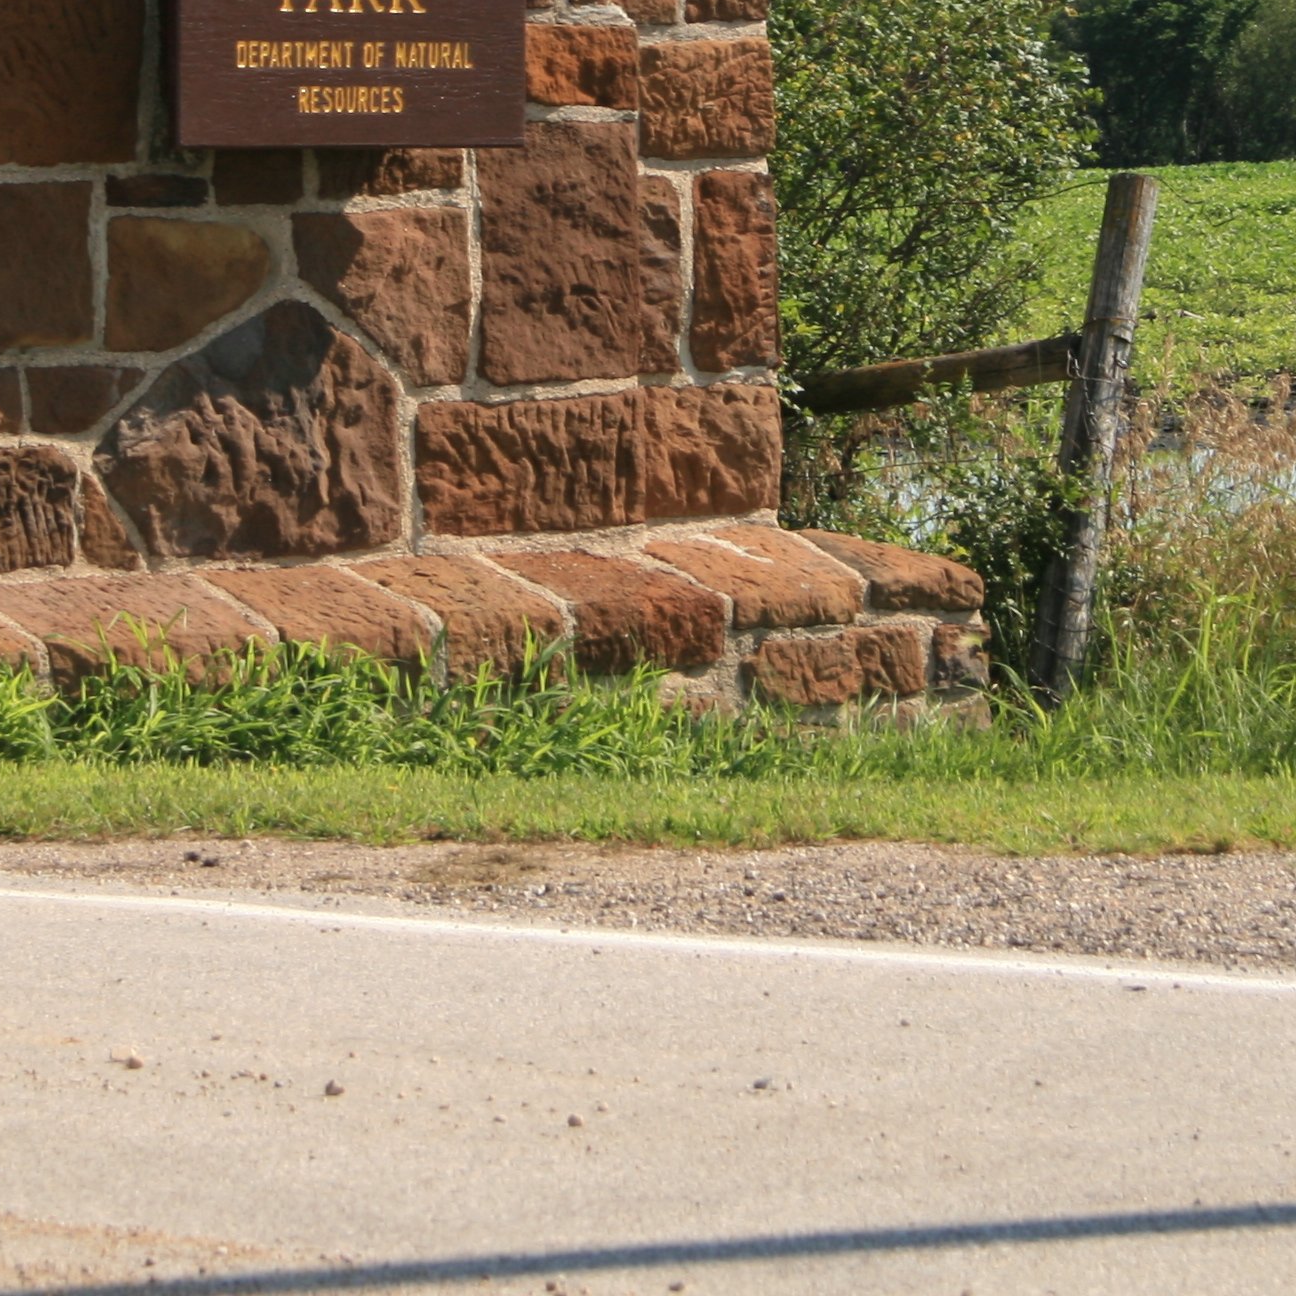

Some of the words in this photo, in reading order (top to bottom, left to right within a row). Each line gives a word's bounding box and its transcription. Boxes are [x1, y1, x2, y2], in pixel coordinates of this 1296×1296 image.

[235, 40, 354, 68] DEPARTMENT
[362, 41, 385, 68] OF
[394, 41, 474, 69] NATURAL
[298, 85, 405, 113] RESOURCES
